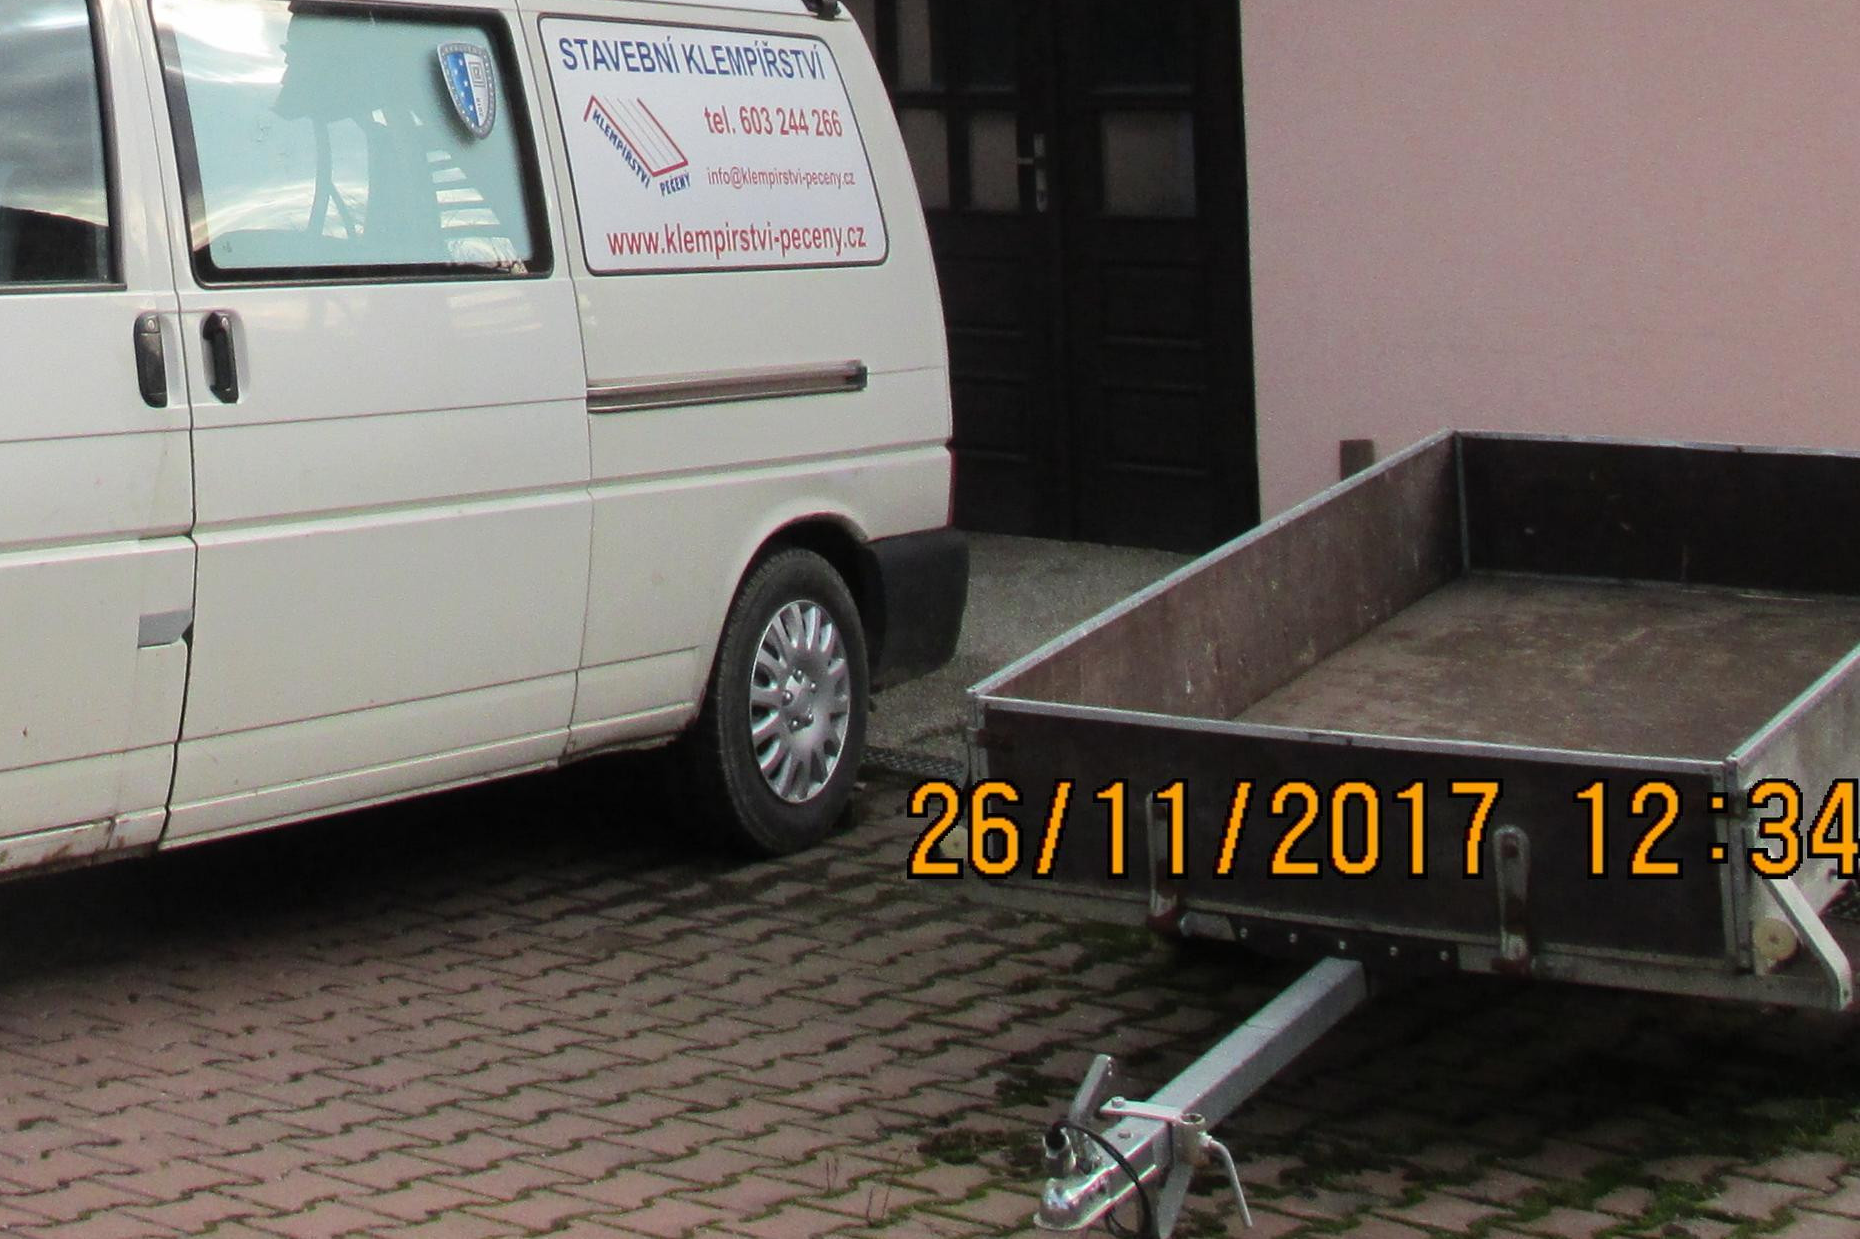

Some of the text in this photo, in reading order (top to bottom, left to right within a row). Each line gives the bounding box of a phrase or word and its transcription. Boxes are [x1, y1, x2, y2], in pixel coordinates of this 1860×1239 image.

[558, 35, 827, 80] STAVEBNÍ KLEMPÍŘSTVÍ
[704, 105, 843, 138] tel. 603 244 266
[706, 165, 856, 191] info@klempirstvi-peceny.cz
[606, 221, 868, 261] www.klempirstvi-peceny.cz
